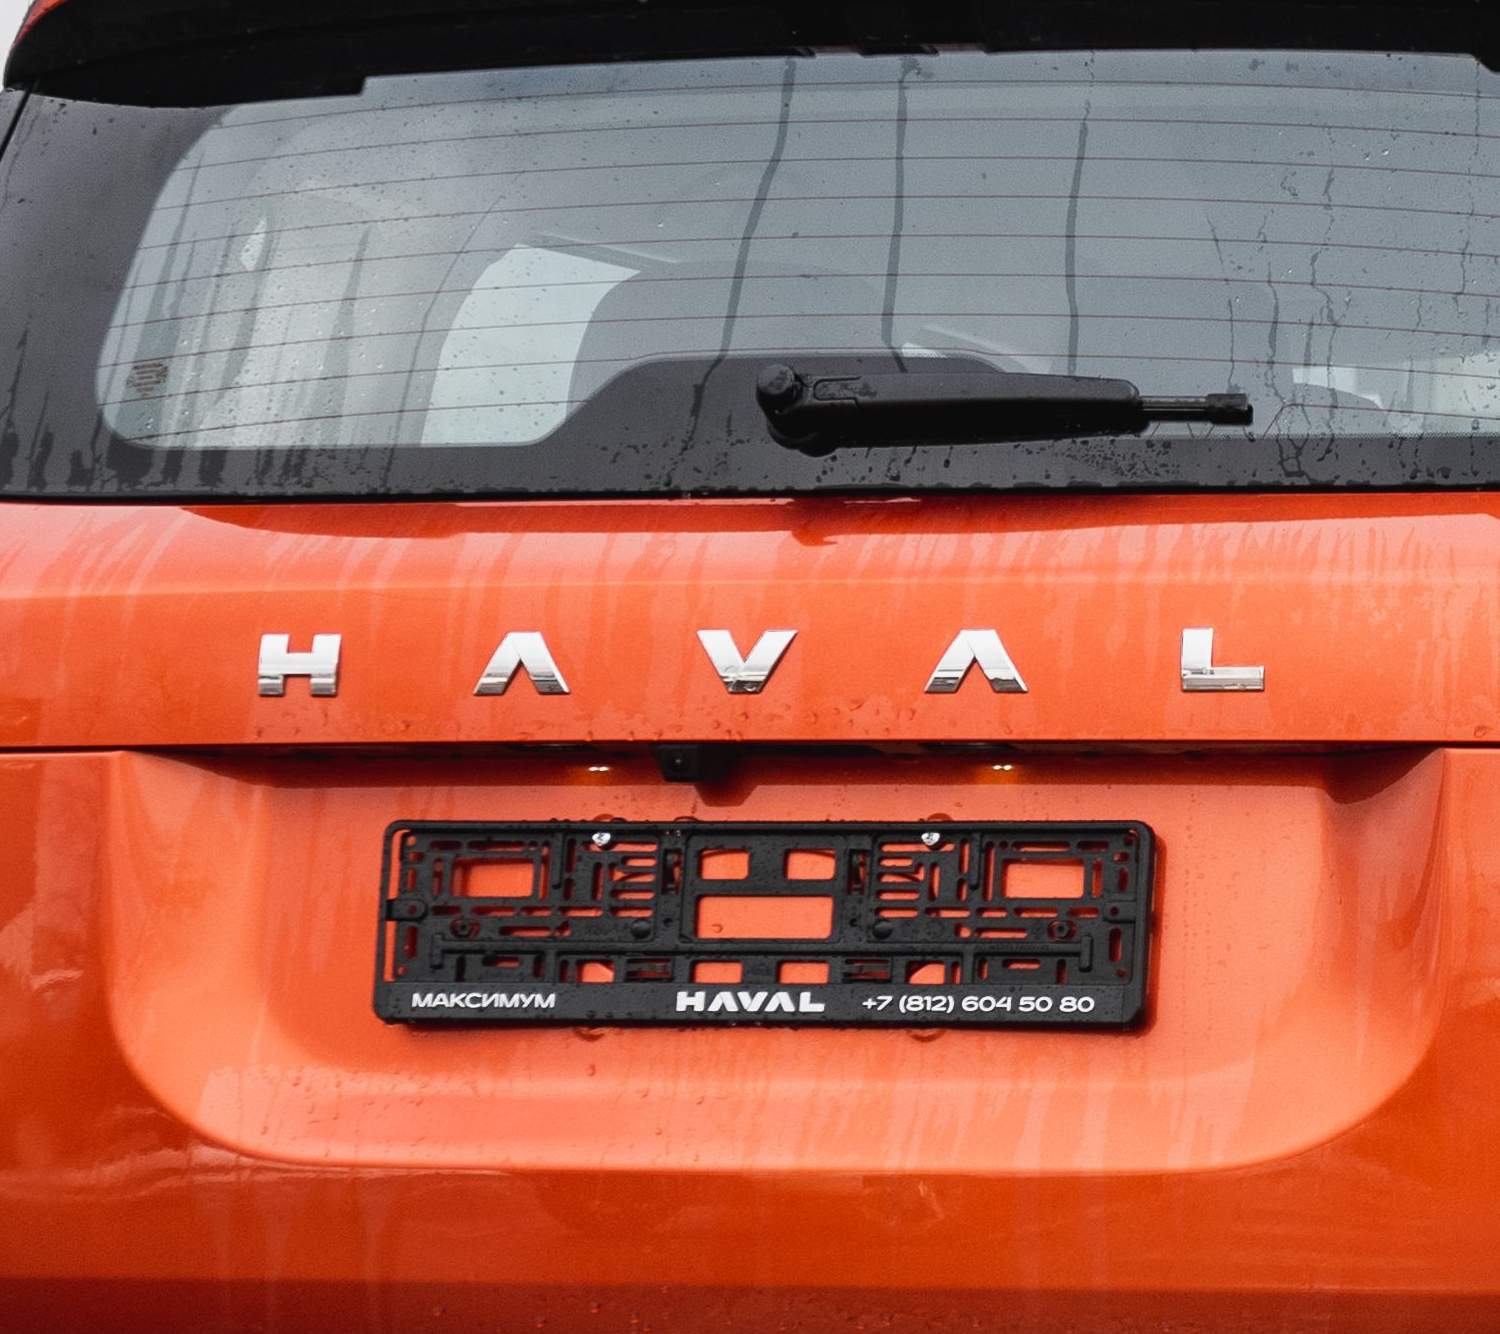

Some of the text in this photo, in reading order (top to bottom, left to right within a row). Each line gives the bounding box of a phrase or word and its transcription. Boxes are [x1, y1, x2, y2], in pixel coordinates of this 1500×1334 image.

[257, 627, 1266, 696] HAVAL
[411, 992, 557, 1009] МАКСИМУМ
[675, 990, 827, 1013] HAVAL
[861, 994, 1095, 1014] +7 (812) 604 50 80
